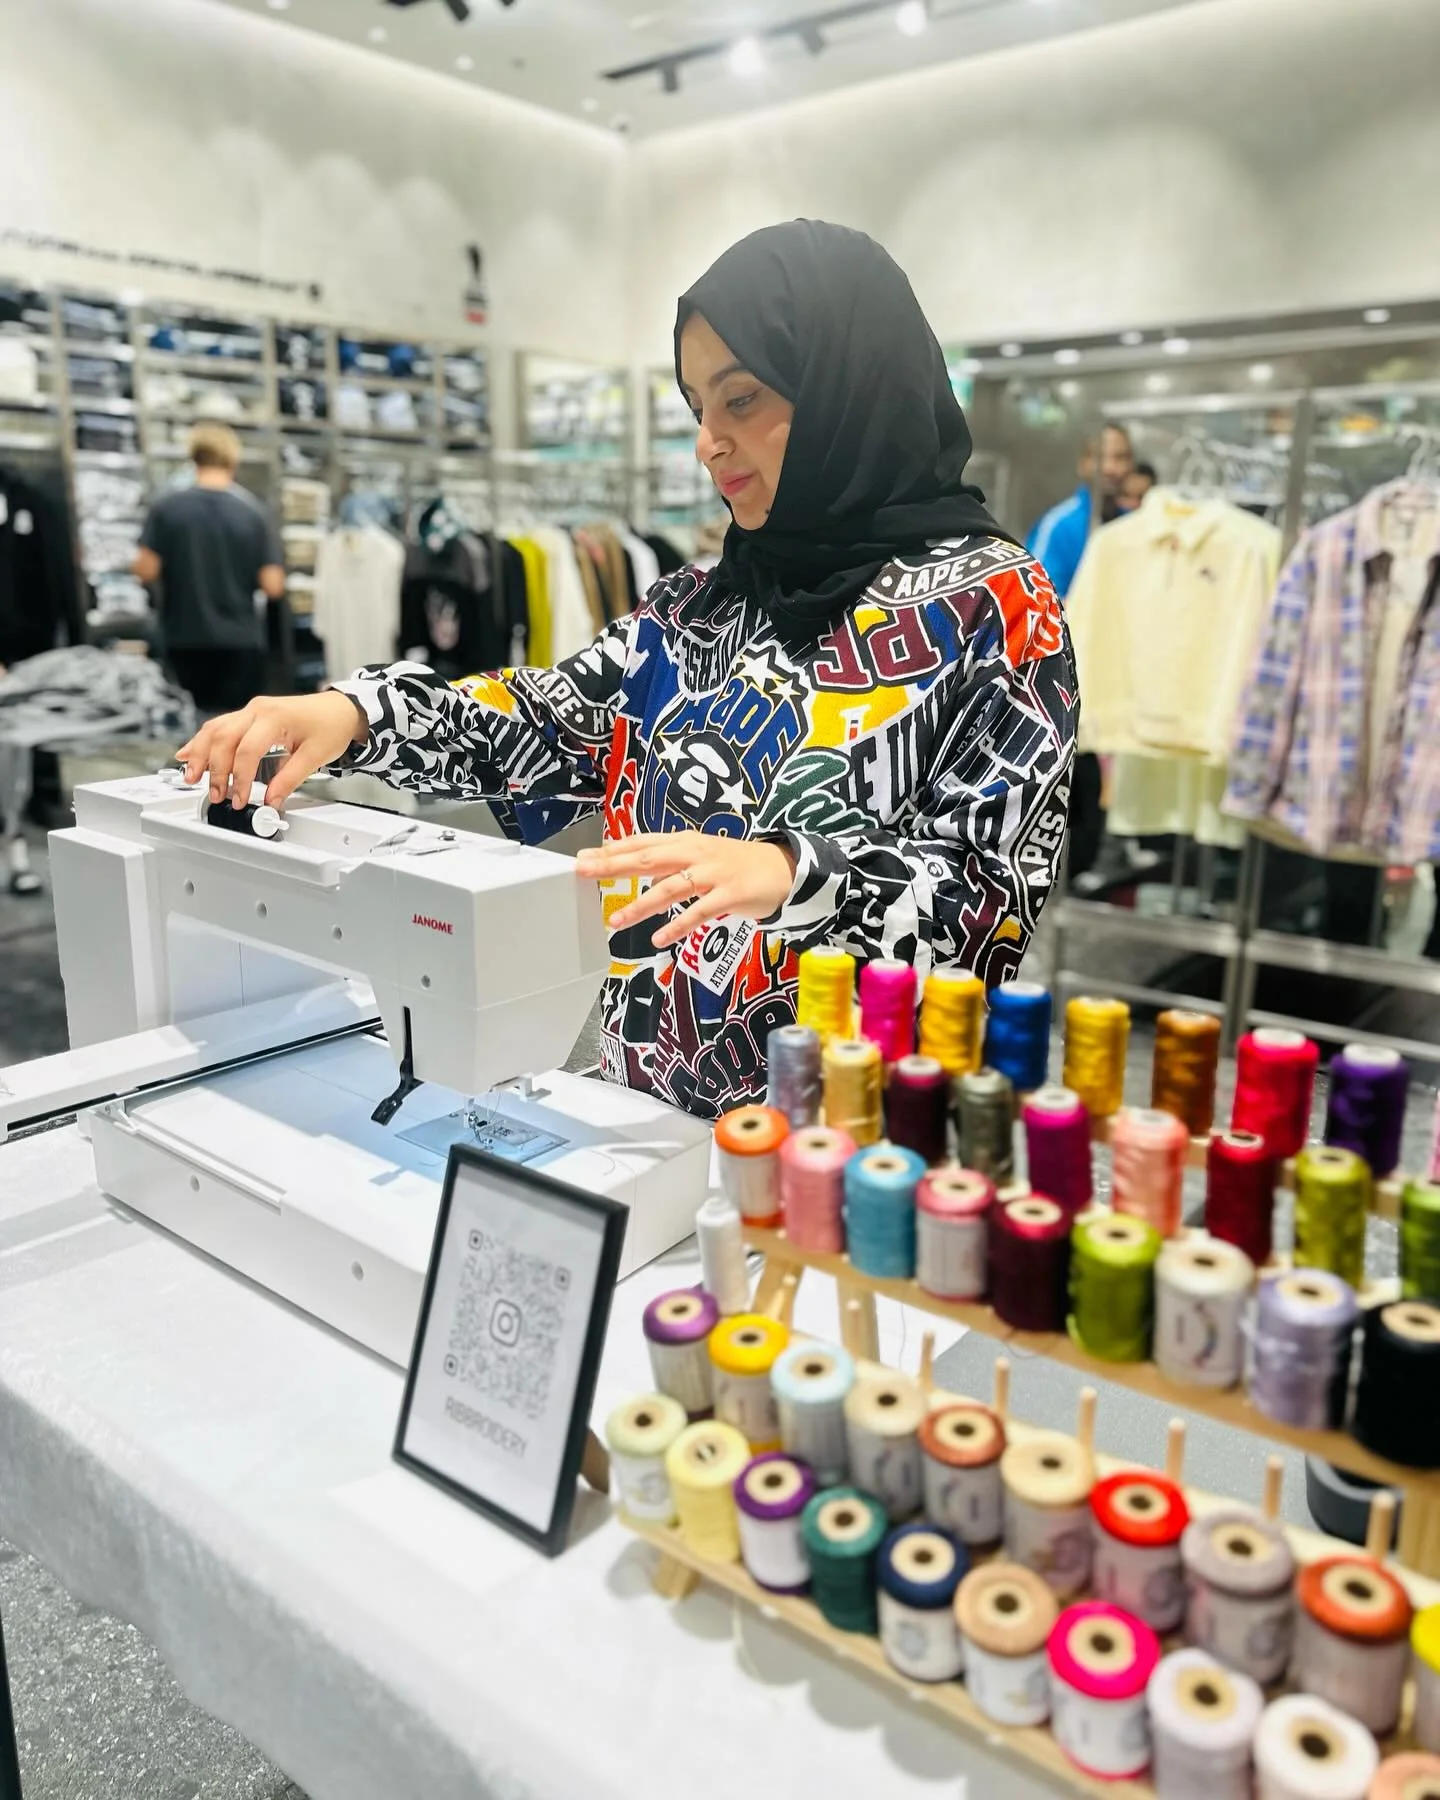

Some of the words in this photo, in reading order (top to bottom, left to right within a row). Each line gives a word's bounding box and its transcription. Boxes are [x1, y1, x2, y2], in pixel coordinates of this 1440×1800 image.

[894, 558, 969, 598] AAPE
[527, 669, 582, 719] AAPE
[1019, 810, 1066, 887] APES
[412, 913, 454, 935] JANOME
[709, 943, 741, 988] ATHLETIC
